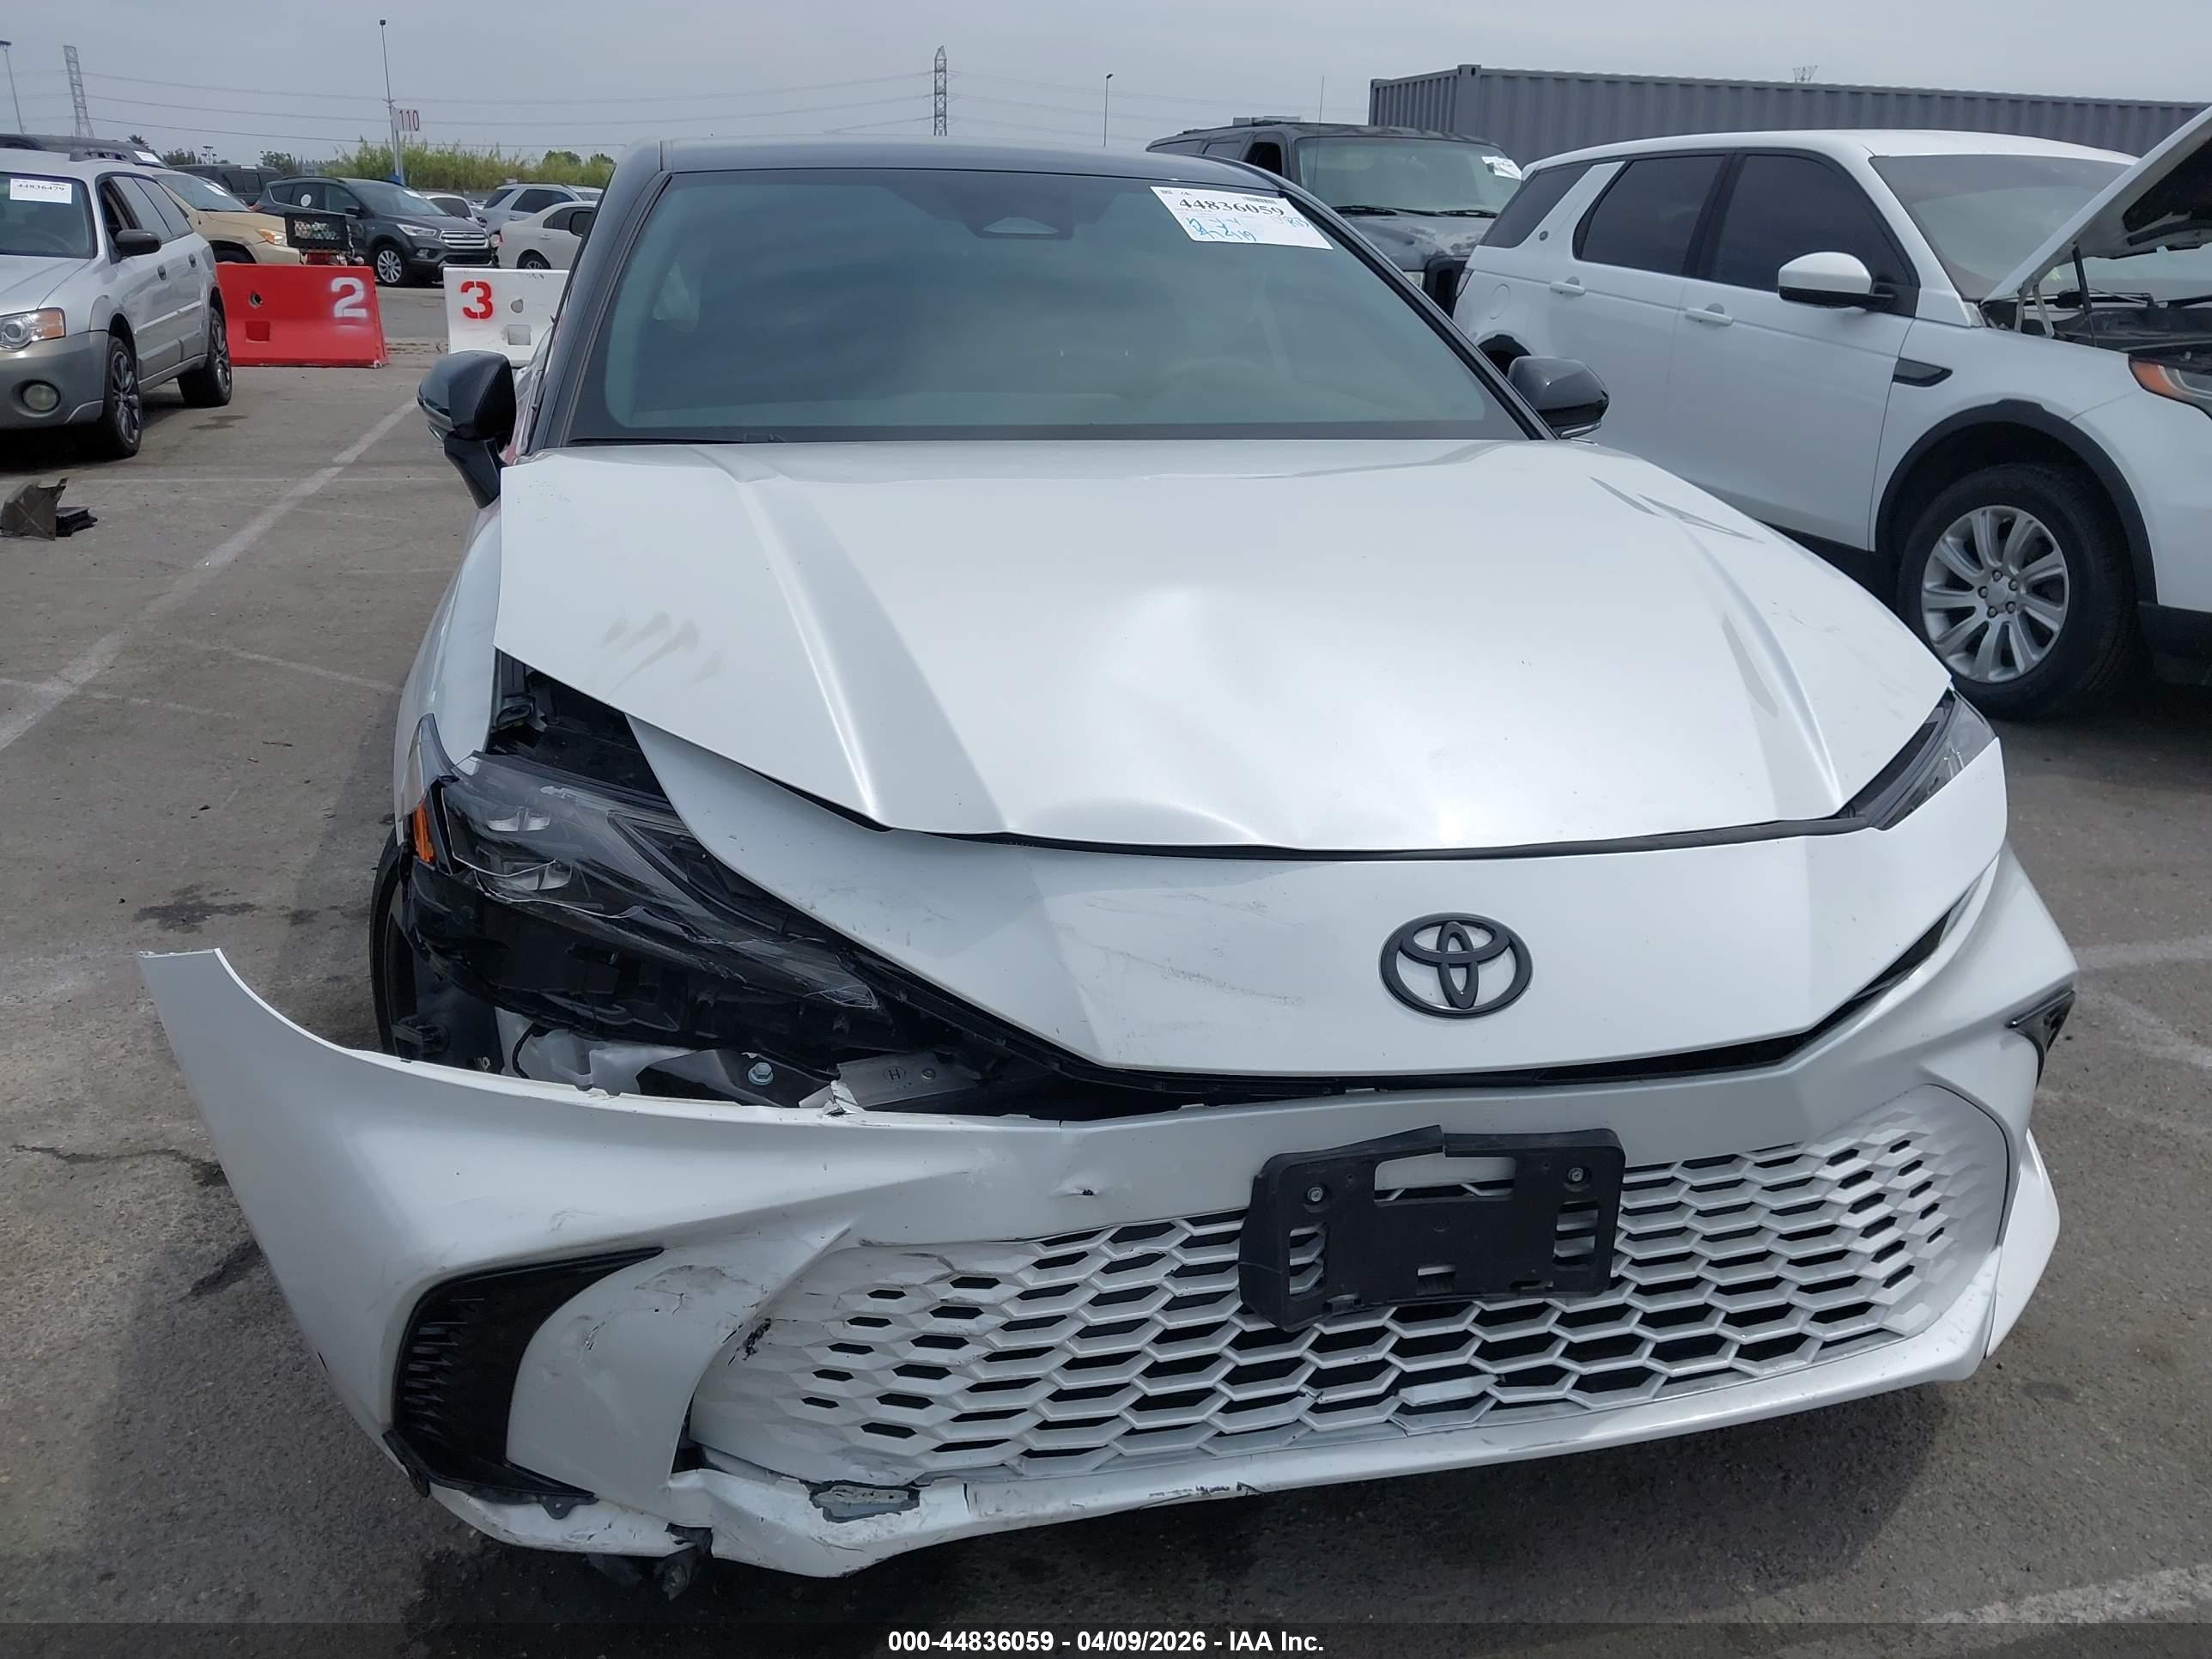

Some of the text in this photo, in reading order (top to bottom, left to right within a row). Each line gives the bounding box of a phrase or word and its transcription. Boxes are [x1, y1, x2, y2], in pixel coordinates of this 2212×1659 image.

[399, 109, 420, 131] 110
[1179, 198, 1285, 216] 44836059
[331, 276, 368, 319] 2
[459, 281, 494, 319] 3
